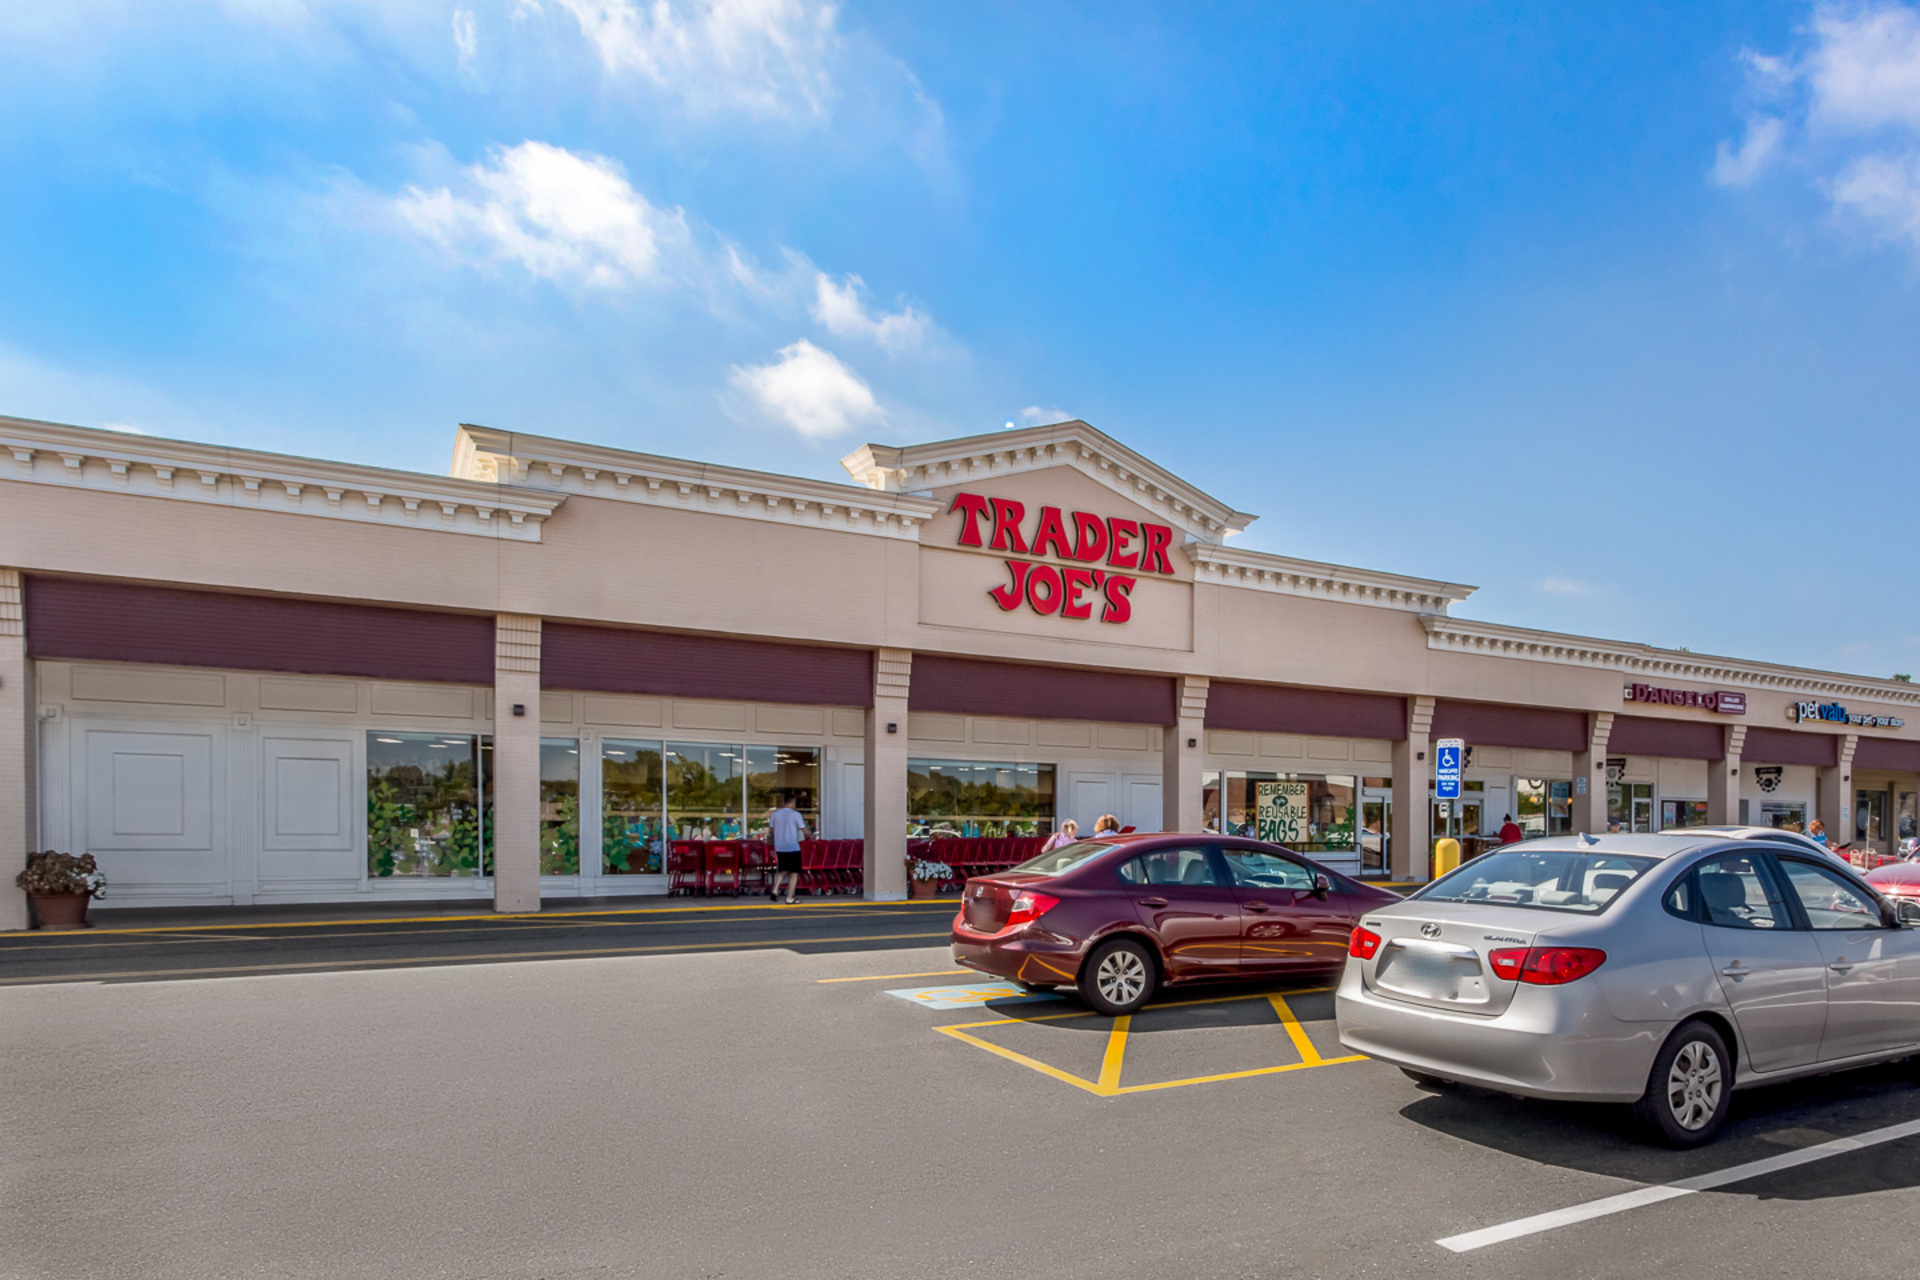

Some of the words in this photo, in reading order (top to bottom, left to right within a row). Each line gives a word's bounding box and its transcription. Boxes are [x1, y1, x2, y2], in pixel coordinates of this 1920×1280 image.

[949, 492, 1174, 574] TRADER
[989, 560, 1136, 623] JOE'S
[1259, 783, 1306, 796] REMEMBER
[1259, 805, 1307, 819] REUSABLE
[1259, 818, 1299, 843] BAGS
